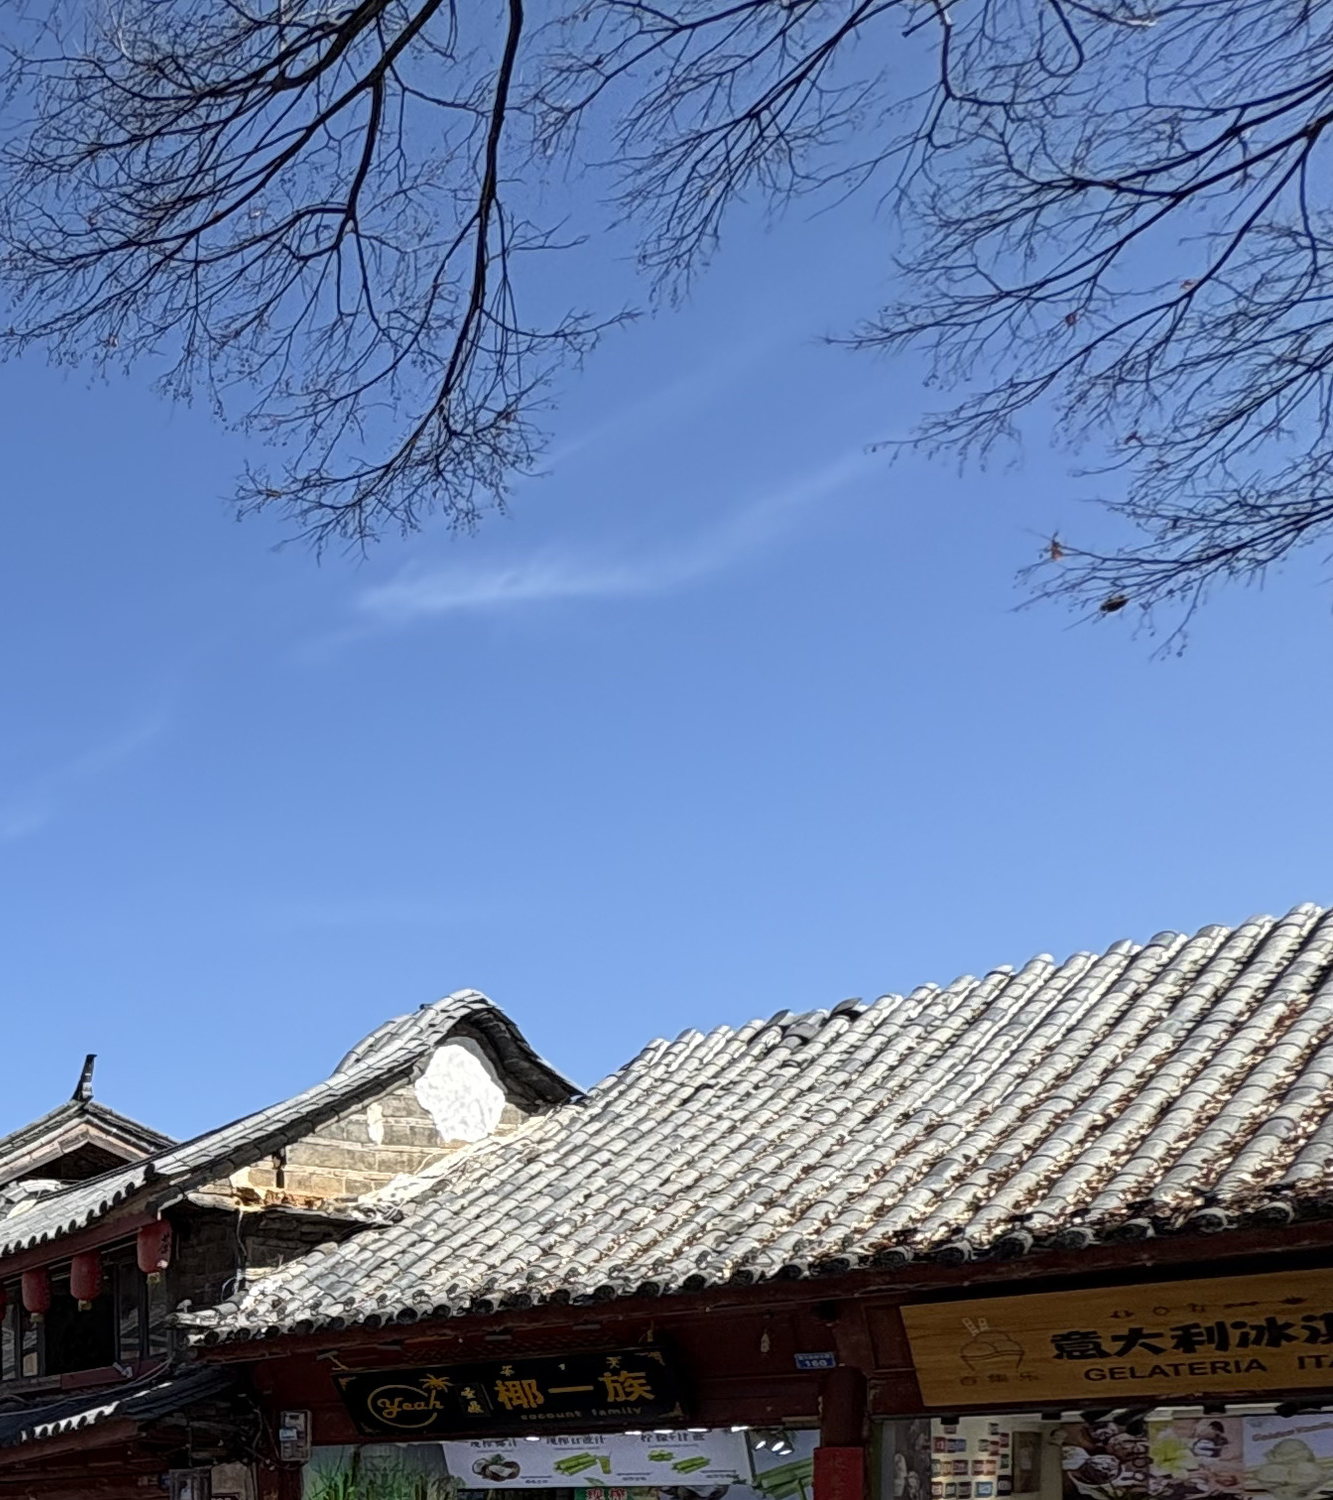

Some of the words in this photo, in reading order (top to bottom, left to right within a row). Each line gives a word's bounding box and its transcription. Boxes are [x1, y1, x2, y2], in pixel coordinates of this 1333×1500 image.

[1084, 1357, 1268, 1382] GELATERIA
[1298, 1353, 1333, 1370] IT
[494, 1370, 656, 1410] 椰一族
[377, 1394, 444, 1418] Yeah
[591, 1405, 642, 1417] family
